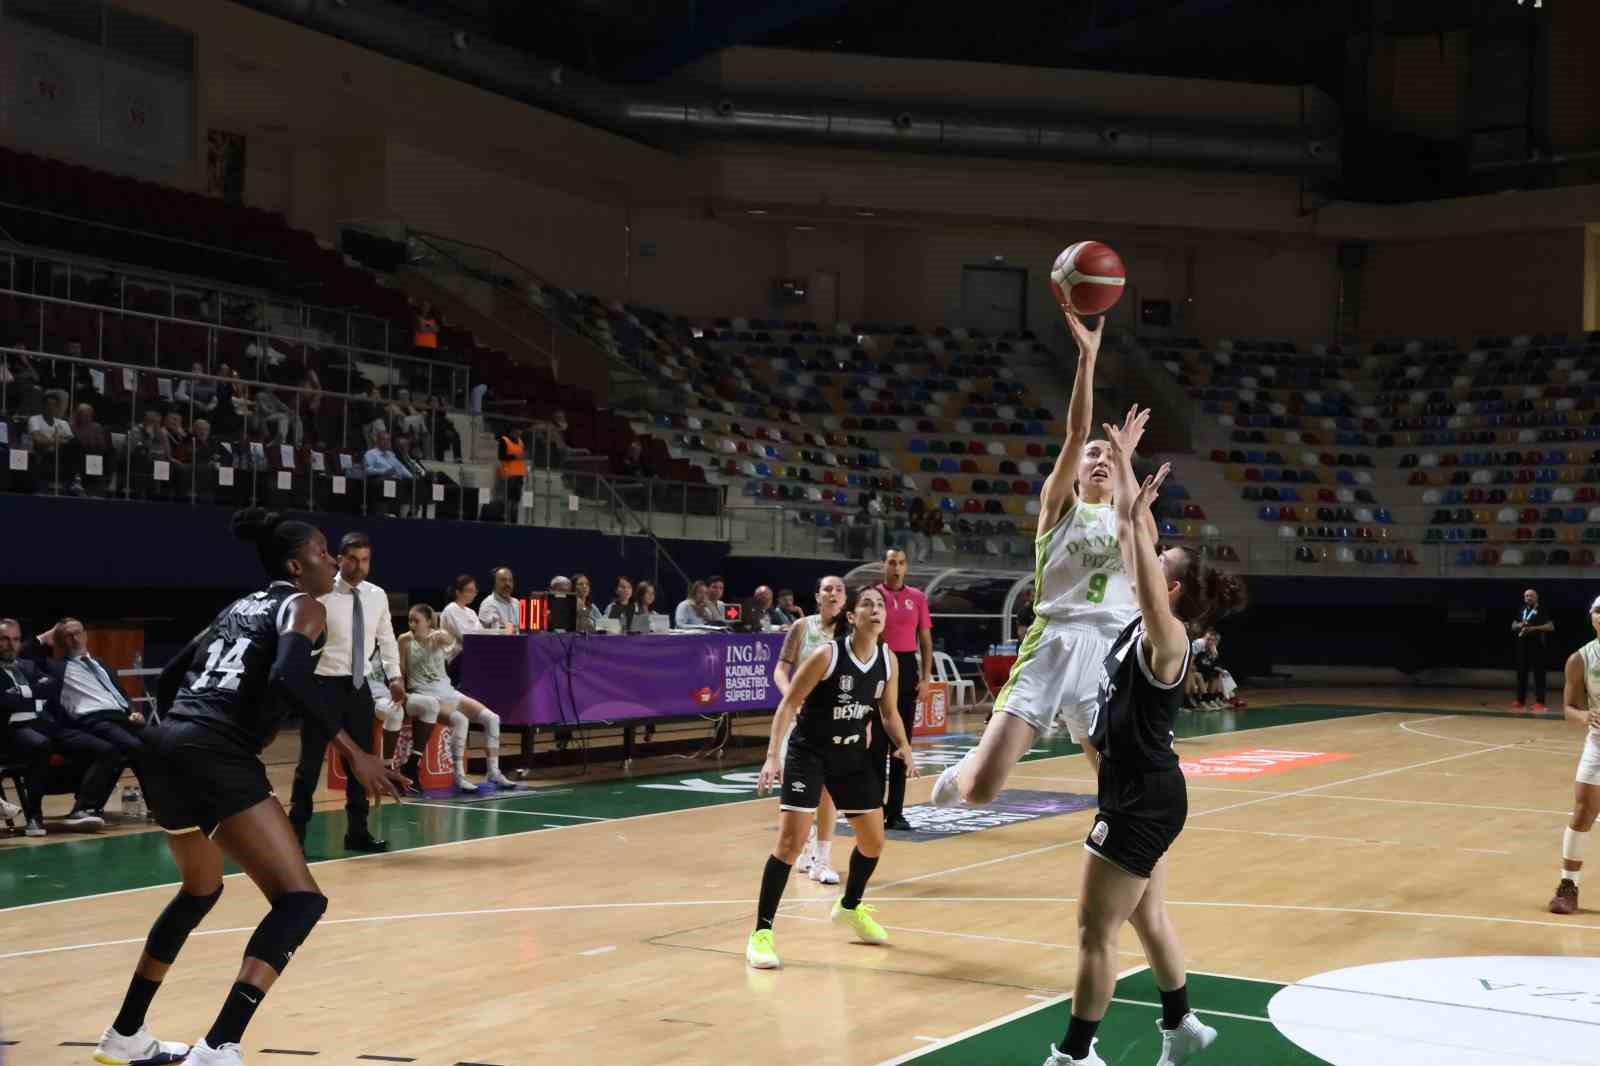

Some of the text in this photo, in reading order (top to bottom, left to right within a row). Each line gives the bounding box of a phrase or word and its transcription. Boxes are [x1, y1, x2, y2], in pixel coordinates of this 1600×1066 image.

[1087, 572, 1109, 603] 9
[191, 637, 252, 690] 14
[727, 645, 753, 662] ING
[725, 677, 770, 689] BASKETBOL
